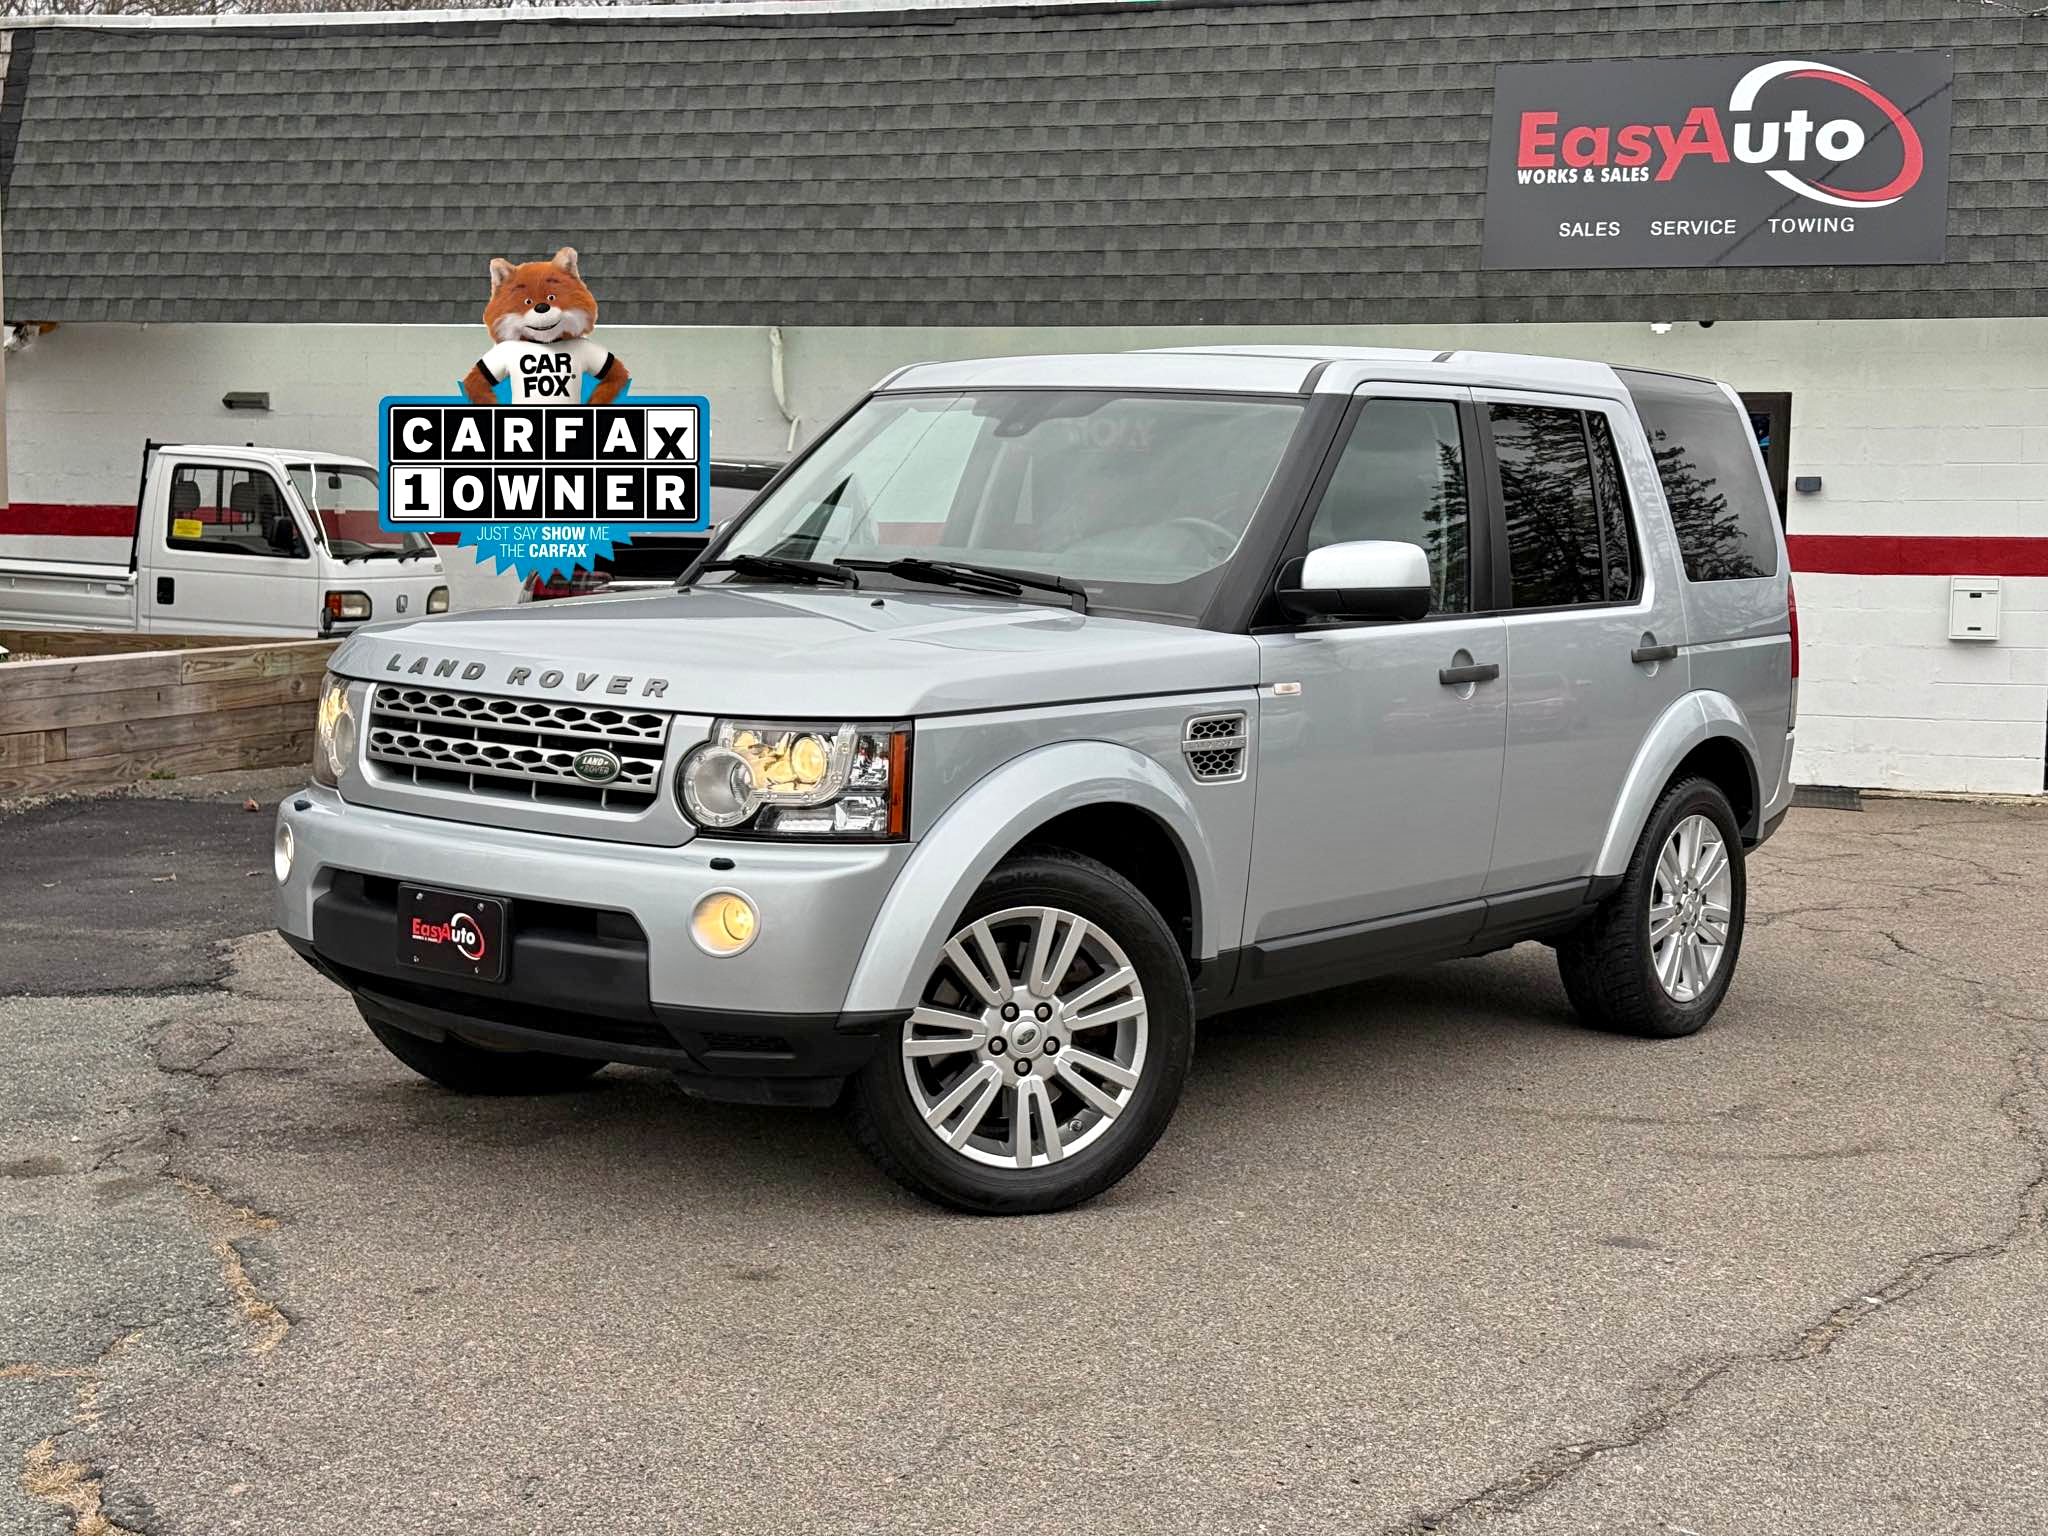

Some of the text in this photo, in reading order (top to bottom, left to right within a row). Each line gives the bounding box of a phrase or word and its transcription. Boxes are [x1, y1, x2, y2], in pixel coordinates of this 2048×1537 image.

[1518, 107, 1865, 182] EasyAuto
[1517, 166, 1650, 185] WORKS & SALES
[1558, 217, 1855, 237] SALES SERVICE TOWING
[386, 653, 669, 698] LAND ROVER
[582, 756, 605, 766] LAND
